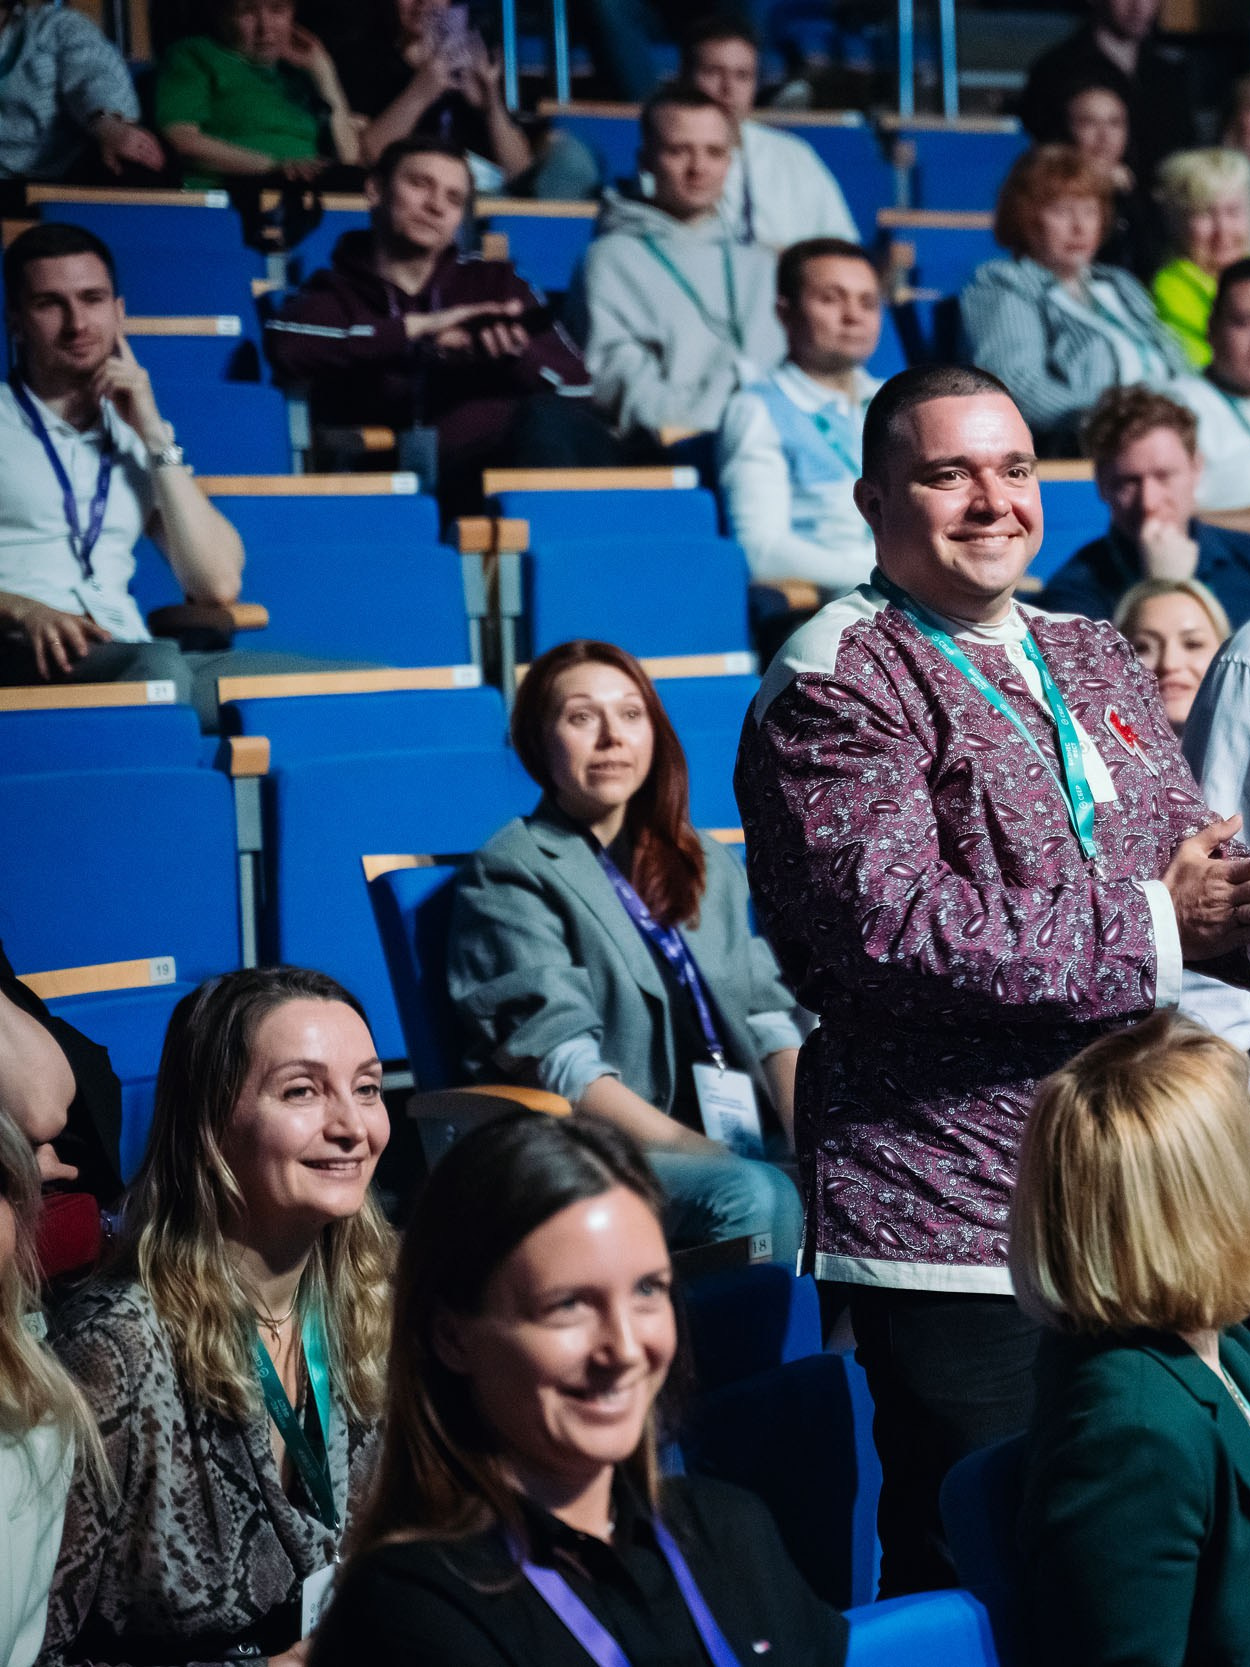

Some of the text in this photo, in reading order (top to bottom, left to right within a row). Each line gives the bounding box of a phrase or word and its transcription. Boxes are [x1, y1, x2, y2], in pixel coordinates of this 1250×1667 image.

[938, 640, 955, 656] СБЕР
[1064, 742, 1074, 767] БИЗНЕС
[1071, 742, 1080, 759] ФЕСТ
[1075, 785, 1085, 801] СБЕР
[156, 962, 169, 977] 19
[753, 1239, 767, 1254] 18
